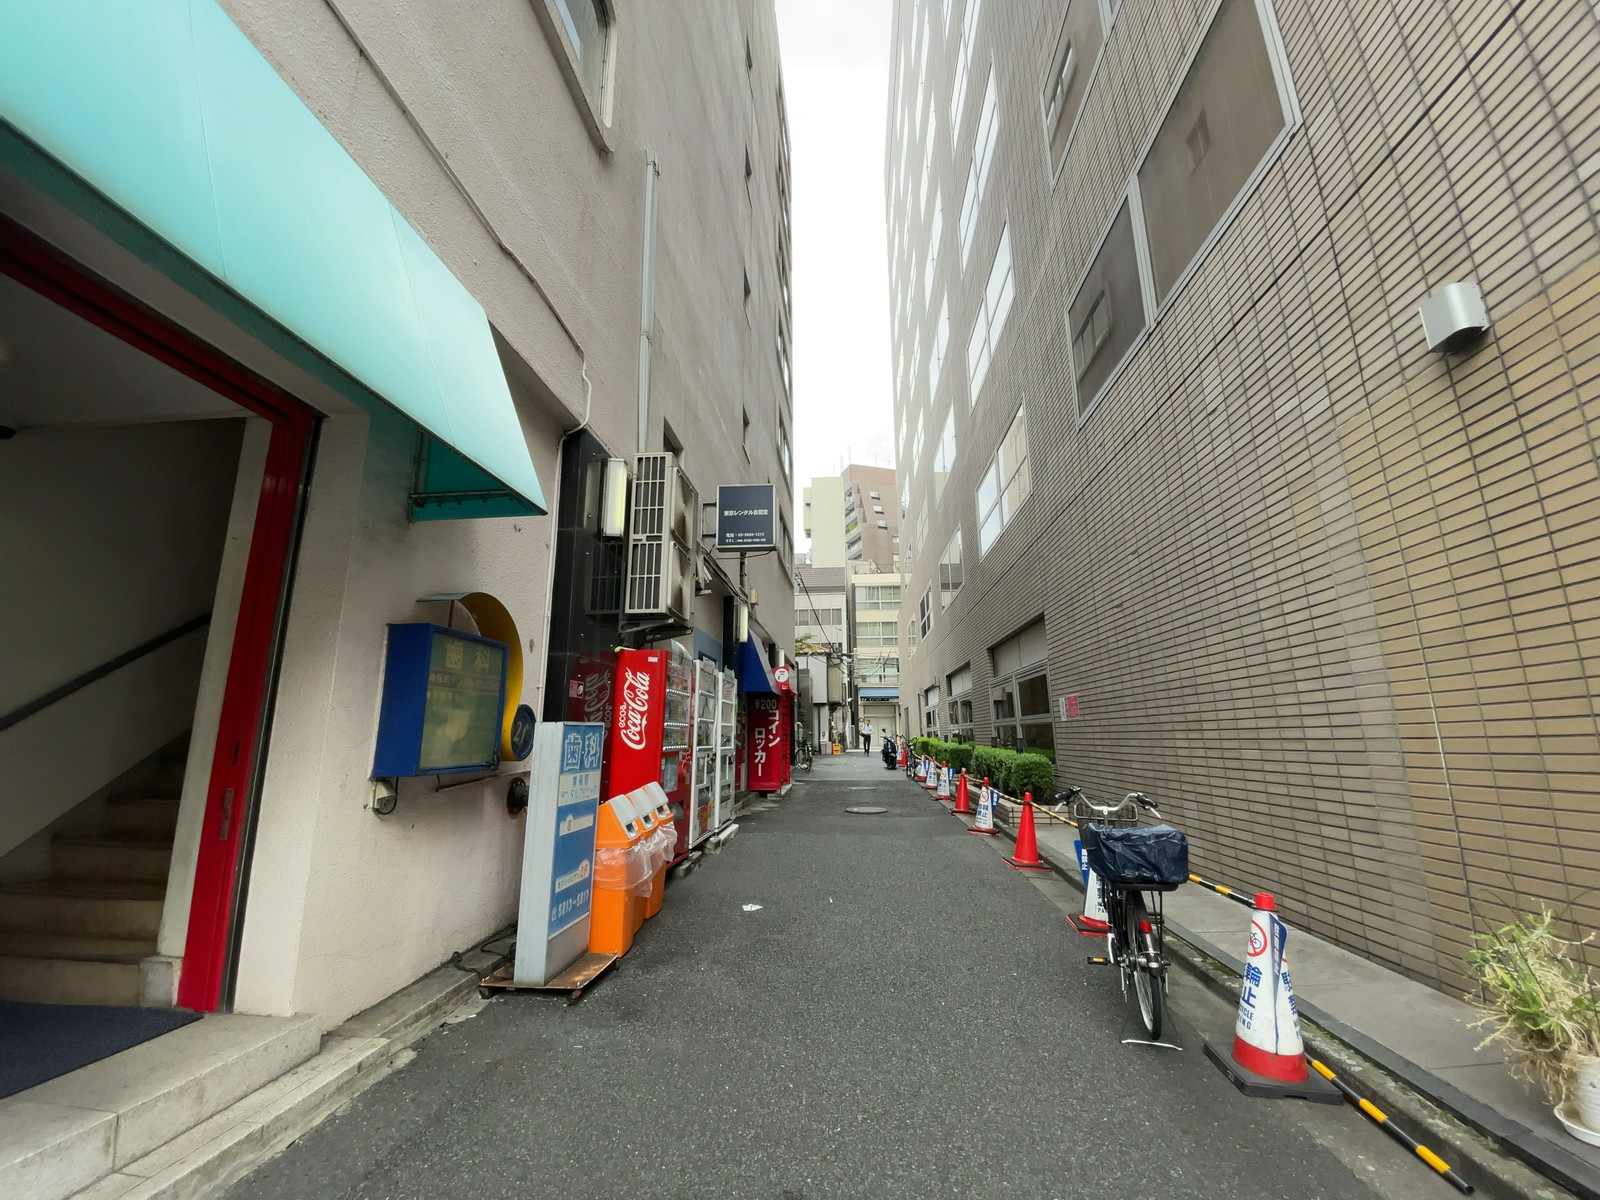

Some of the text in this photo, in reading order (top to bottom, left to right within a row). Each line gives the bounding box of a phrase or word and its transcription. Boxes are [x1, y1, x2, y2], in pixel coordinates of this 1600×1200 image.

[620, 666, 650, 750] Coca-Cola
[754, 699, 777, 710] ¥200
[768, 709, 781, 748] コイン
[563, 732, 601, 771] 歯科
[754, 727, 766, 777] ロッカー
